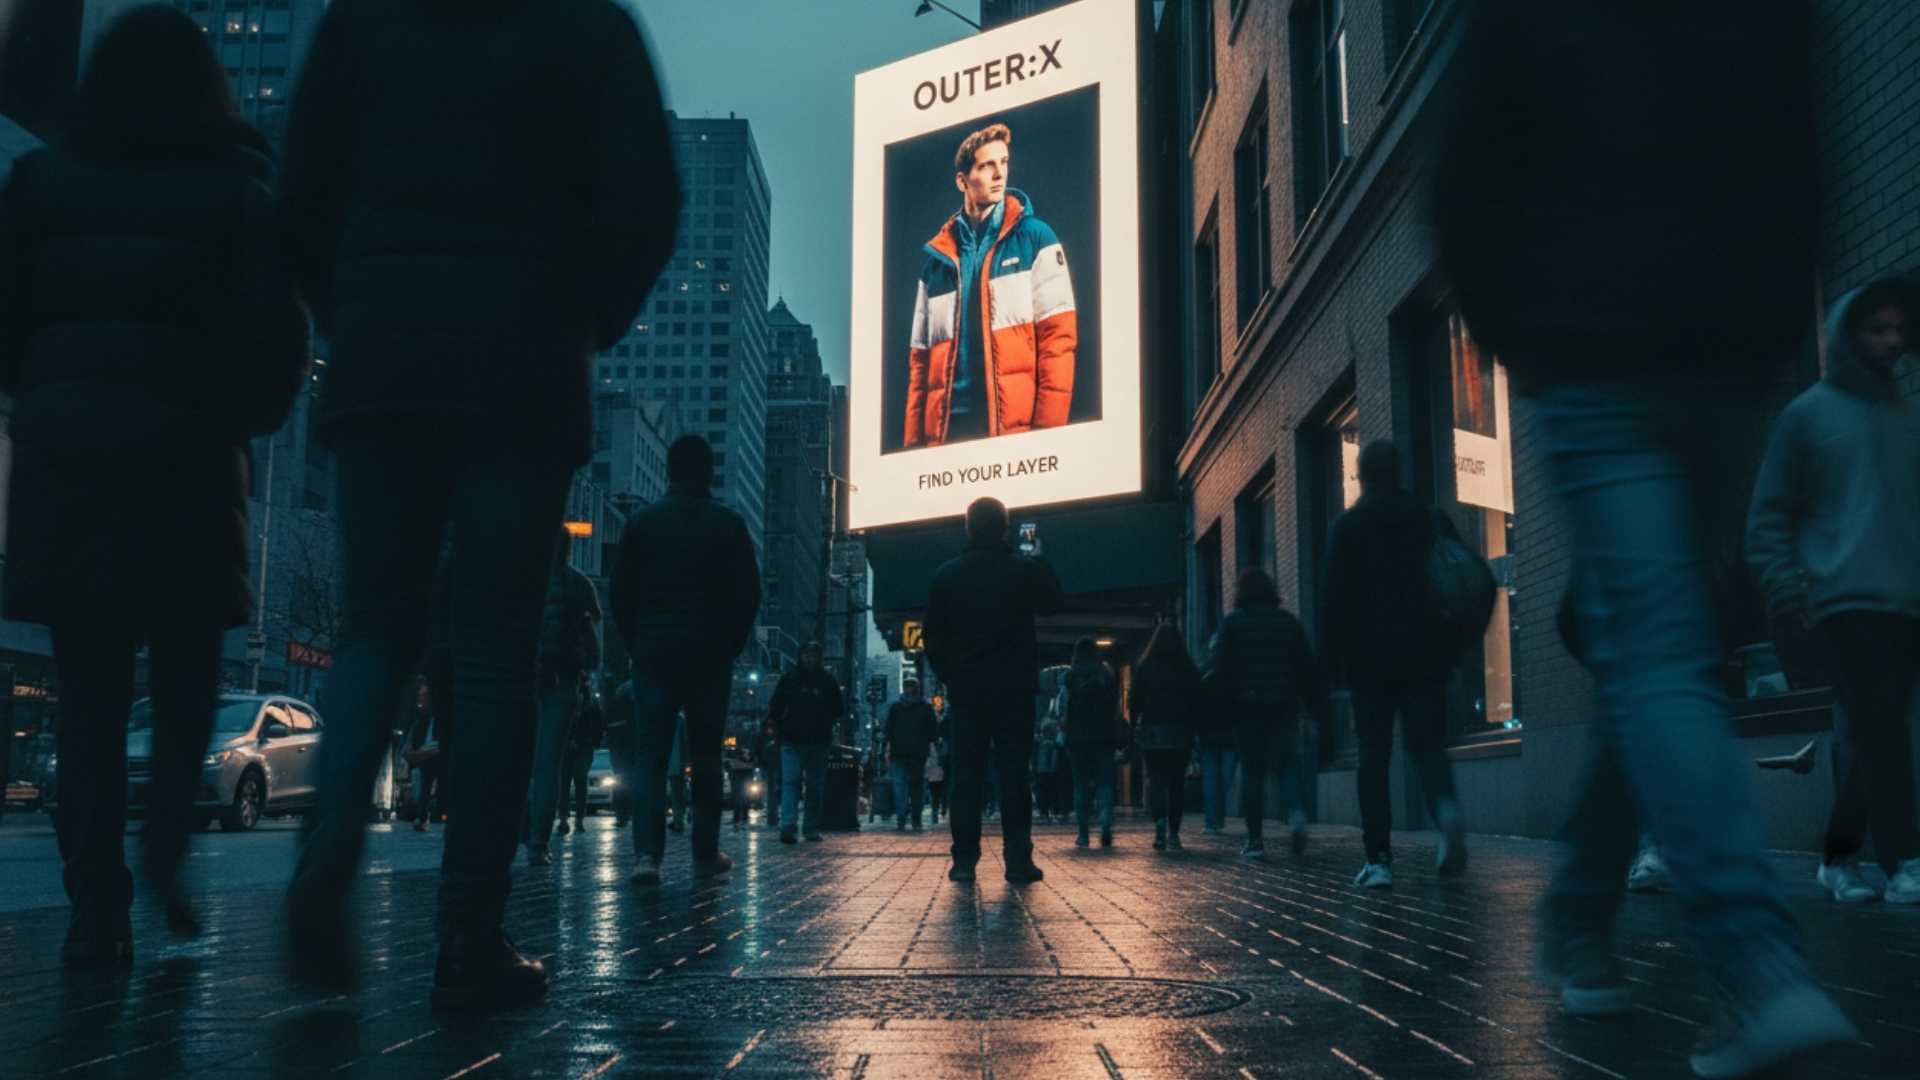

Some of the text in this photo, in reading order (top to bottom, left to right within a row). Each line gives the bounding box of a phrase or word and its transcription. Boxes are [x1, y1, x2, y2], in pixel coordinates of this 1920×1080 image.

[913, 39, 1062, 110] OUTER:X
[918, 455, 1058, 490] FIND YOUR LAYER
